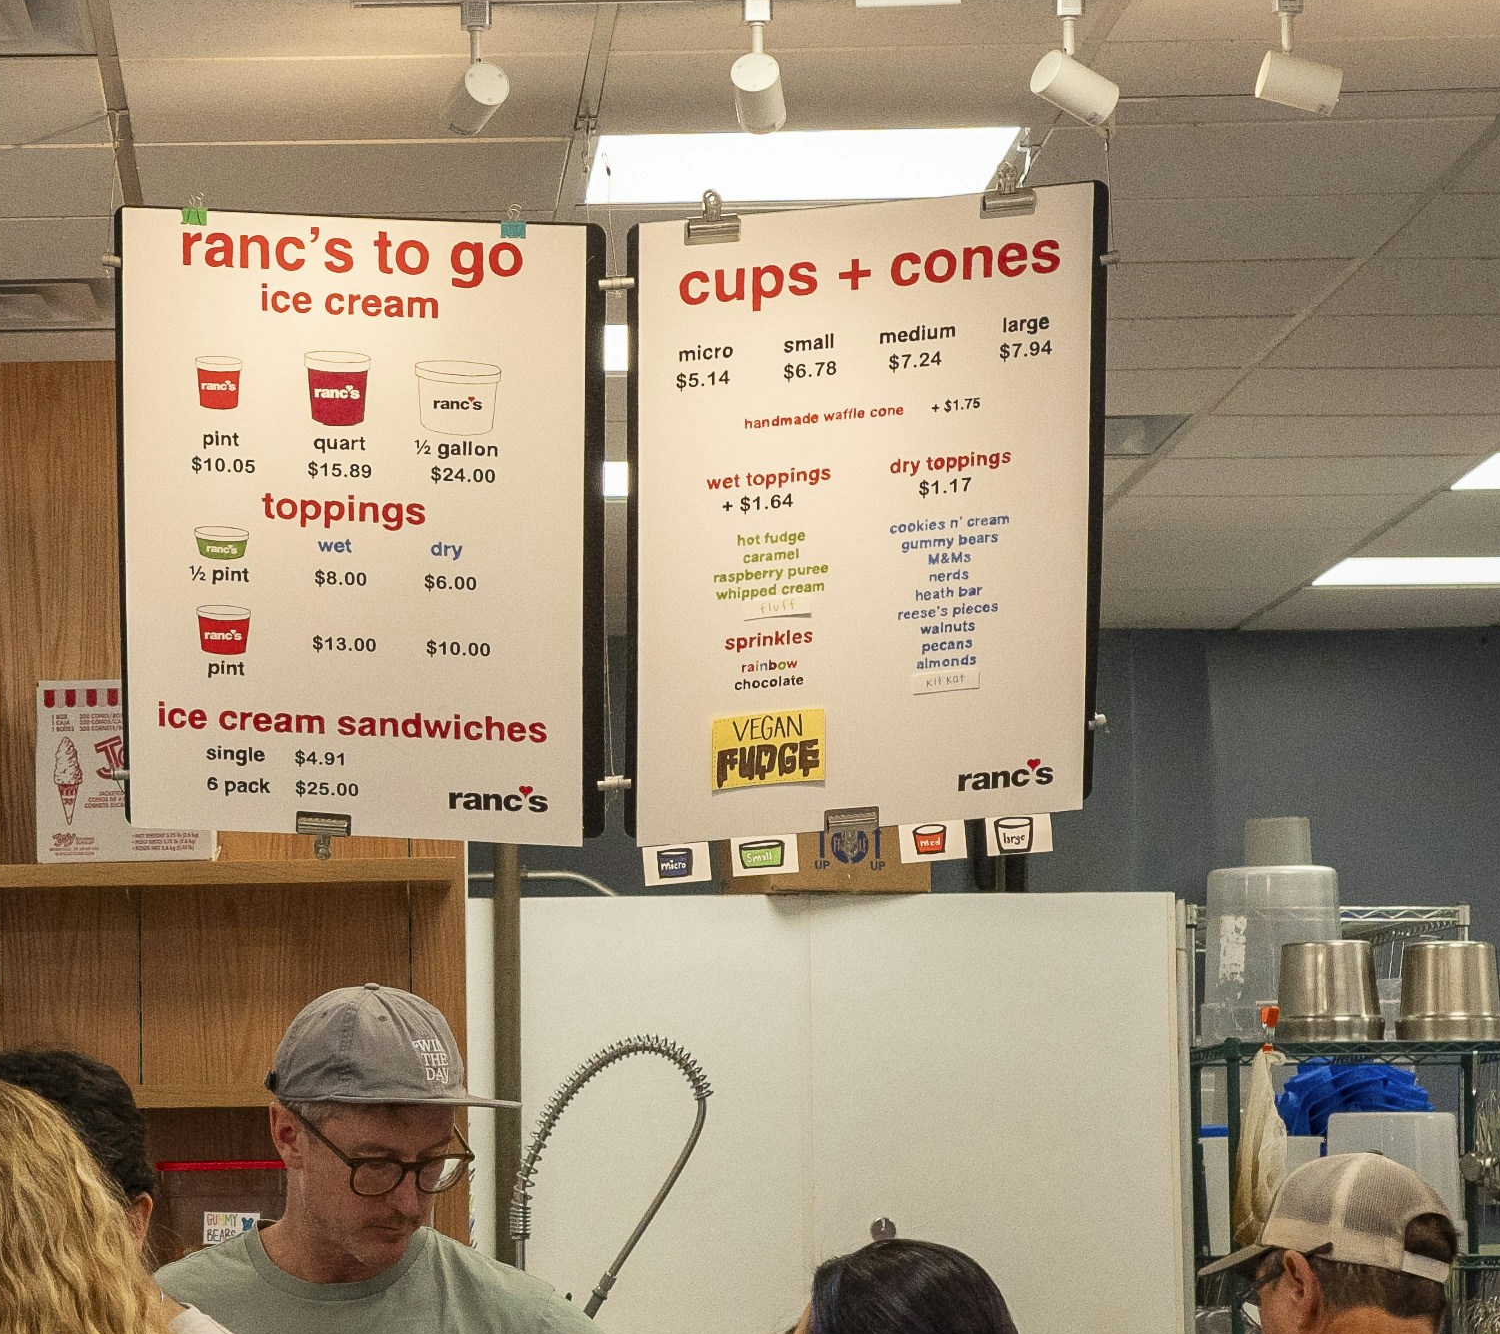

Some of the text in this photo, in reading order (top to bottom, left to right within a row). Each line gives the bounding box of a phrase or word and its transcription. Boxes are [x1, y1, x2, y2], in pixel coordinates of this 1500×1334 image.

[183, 227, 523, 288] ranc's to go
[679, 239, 1060, 312] cups + cones
[262, 283, 438, 319] ice cream
[678, 314, 1049, 362] micro small medium large
[676, 340, 1052, 390] $5.14 $6.78 $7.24 $7.94
[203, 431, 239, 449] pint
[313, 436, 365, 453] quart
[438, 440, 498, 458] gallon
[191, 456, 495, 483] $10.05 $15.89 $24.00
[890, 449, 1012, 477] dry toppings
[707, 466, 831, 490] wet toppings
[262, 493, 426, 531] toppings
[318, 539, 463, 560] wet dry
[725, 629, 813, 653] sprinkles
[158, 701, 547, 743] ice cream sandwiches
[732, 714, 803, 742] VEGAN
[717, 738, 820, 788] FUDGE
[660, 859, 686, 871] micro
[421, 1053, 449, 1066] THE
[425, 1068, 449, 1083] DAY
